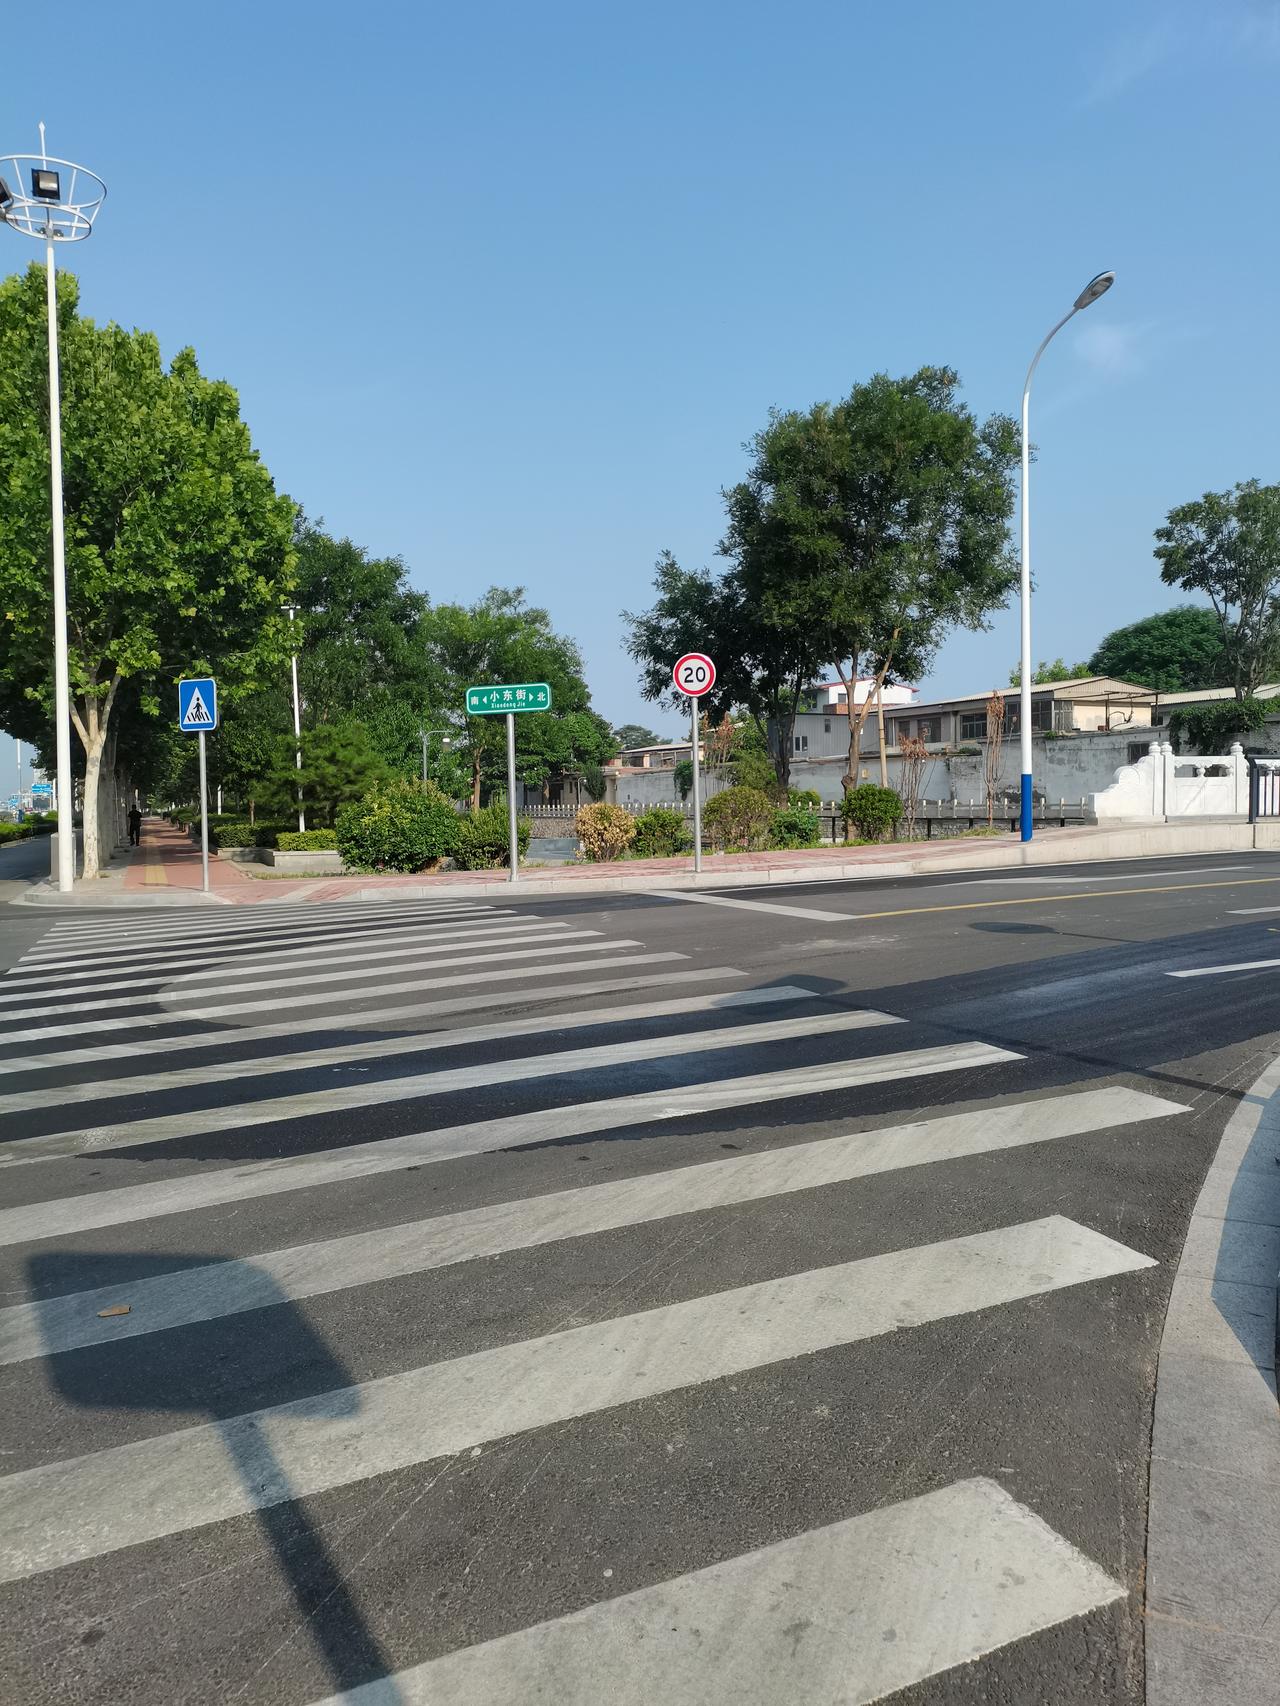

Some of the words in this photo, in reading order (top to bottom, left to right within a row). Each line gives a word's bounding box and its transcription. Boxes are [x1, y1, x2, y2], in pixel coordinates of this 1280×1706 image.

[683, 666, 706, 683] 20
[470, 695, 479, 706] 南
[490, 689, 526, 702] 小东街
[537, 691, 546, 702] 北
